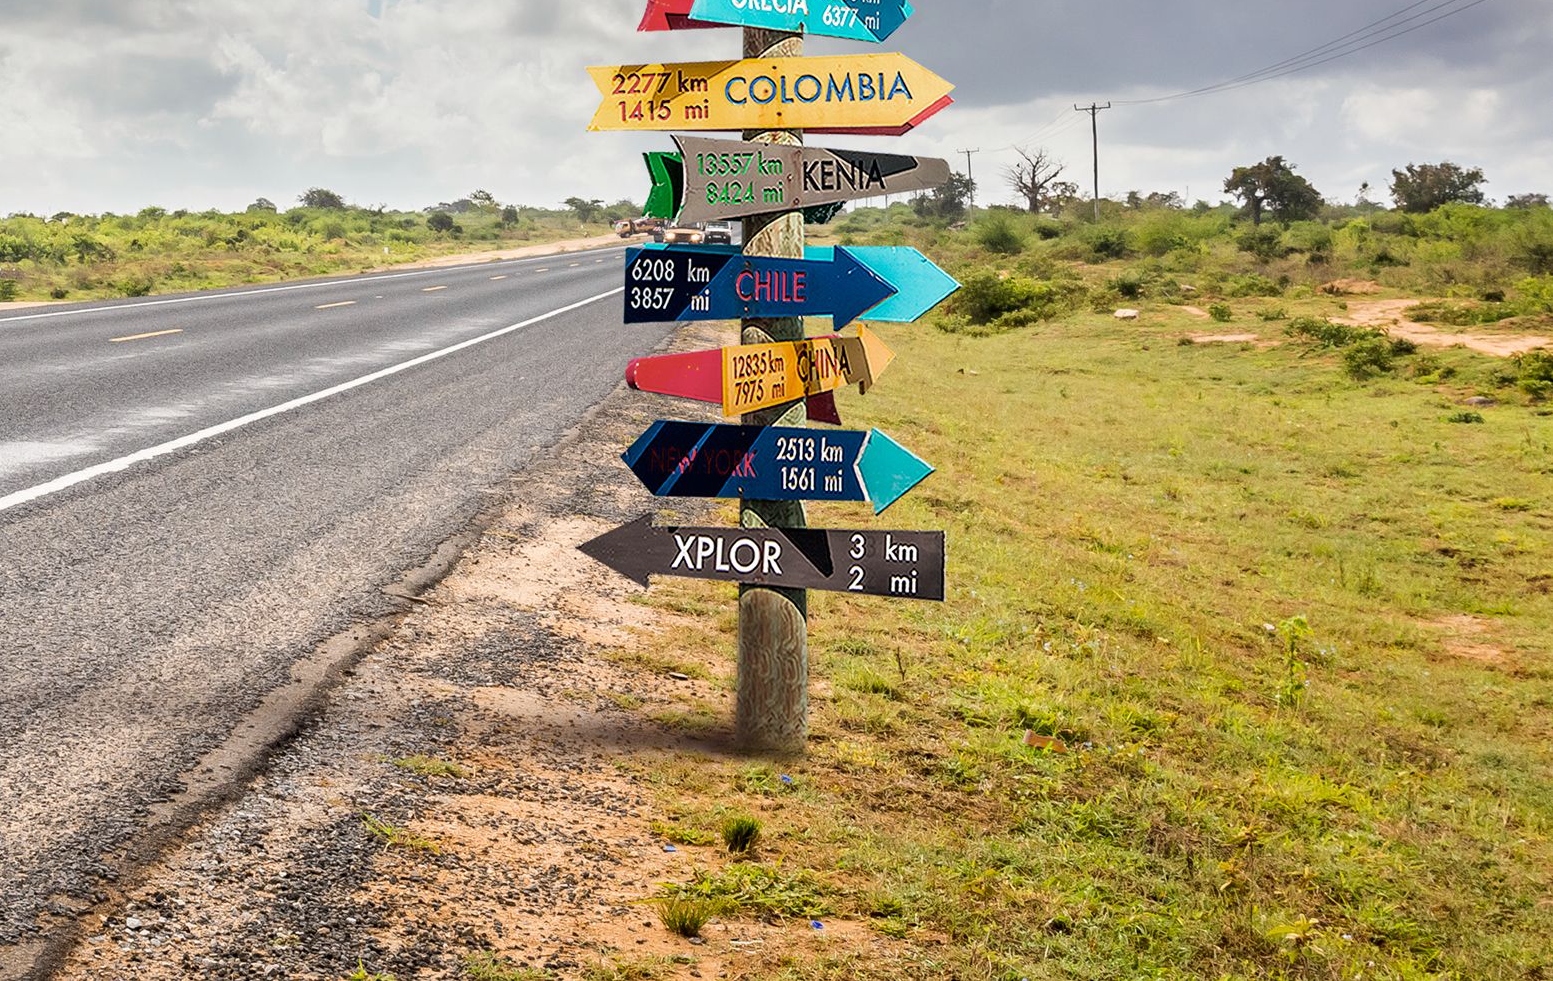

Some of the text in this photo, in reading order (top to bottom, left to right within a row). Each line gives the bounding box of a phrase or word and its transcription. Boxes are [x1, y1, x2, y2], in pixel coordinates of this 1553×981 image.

[822, 4, 881, 31] 6377 mi
[611, 70, 708, 96] 2277 km
[724, 71, 913, 106] COLOMBIA
[618, 98, 710, 123] 1415 mi
[696, 150, 783, 177] 13557 km
[802, 158, 886, 193] KENIA
[705, 180, 784, 206] 8424 mi
[631, 258, 710, 283] 6208 km
[630, 286, 710, 312] 3857 mi
[736, 269, 807, 303] CHILE
[732, 349, 784, 379] 12835 km
[797, 345, 852, 384] CHINA
[734, 376, 785, 406] 7975 mi
[649, 445, 758, 479] NEW YORK
[776, 436, 844, 463] 2513 km
[780, 466, 843, 493] 1561 mi
[670, 534, 783, 576] XPLOR
[849, 534, 919, 563] 3 km
[848, 565, 918, 594] 2 mi
